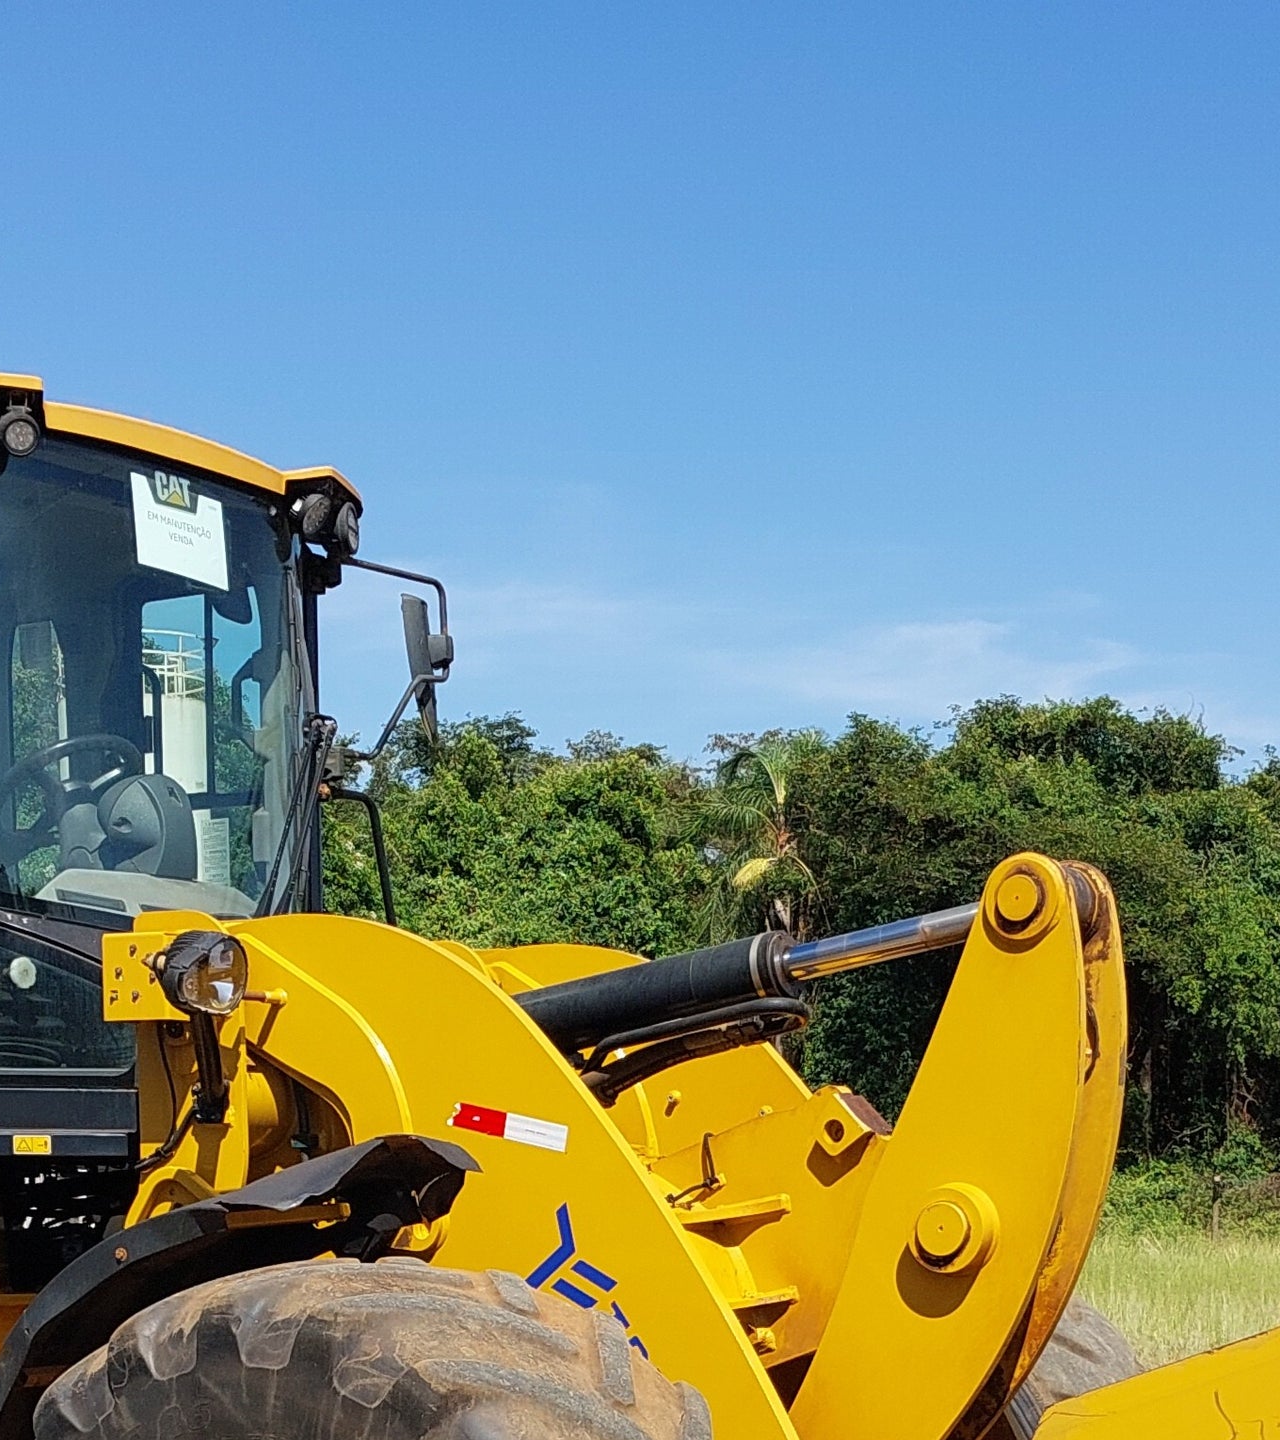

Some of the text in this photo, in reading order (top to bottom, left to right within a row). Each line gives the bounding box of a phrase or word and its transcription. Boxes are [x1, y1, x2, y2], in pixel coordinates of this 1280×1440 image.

[154, 470, 191, 508] CAT
[147, 510, 159, 522] EM
[168, 531, 194, 547] VENDA
